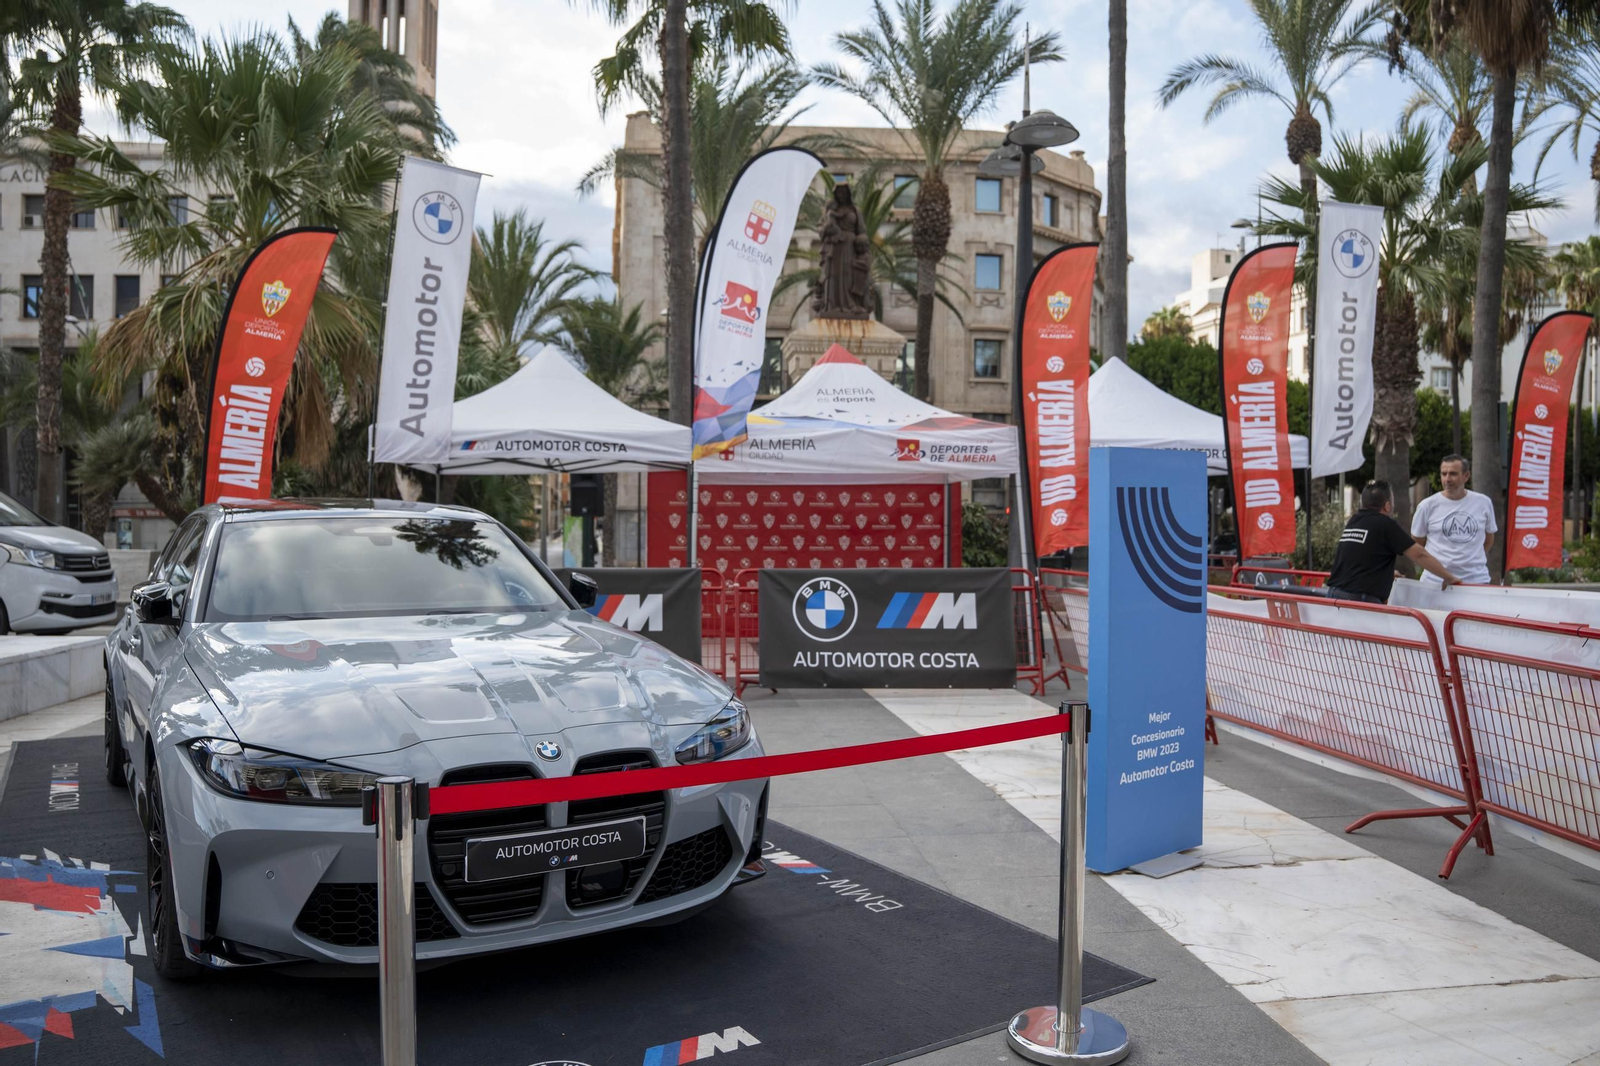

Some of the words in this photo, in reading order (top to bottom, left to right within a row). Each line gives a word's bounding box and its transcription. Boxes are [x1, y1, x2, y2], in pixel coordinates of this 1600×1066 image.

[727, 238, 773, 266] ALMERÍA
[399, 256, 443, 438] Automotor
[1328, 291, 1358, 450] Automotor
[817, 387, 874, 396] ALMERÍA
[833, 396, 876, 404] deporte
[1028, 379, 1076, 467] ALMERÍA
[1230, 381, 1279, 471] ALMERÍA
[218, 384, 272, 490] ALMERÍA
[495, 440, 581, 451] AUTOMOTOR
[584, 440, 627, 453] COSTA
[749, 437, 816, 451] ALMERÍA
[749, 452, 784, 460] CIUDAD
[930, 445, 988, 454] DEPORTES
[947, 454, 996, 463] ALMERIA
[1516, 423, 1554, 500] ALMERÍA
[1040, 474, 1076, 507] UD
[1244, 478, 1281, 508] UD
[1515, 505, 1548, 529] UD
[801, 580, 850, 599] BMW
[793, 651, 915, 668] AUTOMOTOR
[919, 652, 980, 669] COSTA
[1148, 711, 1171, 724] Mejor
[1131, 726, 1185, 745] Concesionario
[1137, 747, 1158, 761] BMW
[1160, 742, 1179, 756] 2023
[1119, 765, 1169, 785] Automotor
[1170, 759, 1195, 773] Costa
[495, 837, 579, 859] AUTOMOTOR
[582, 831, 622, 847] COSTA
